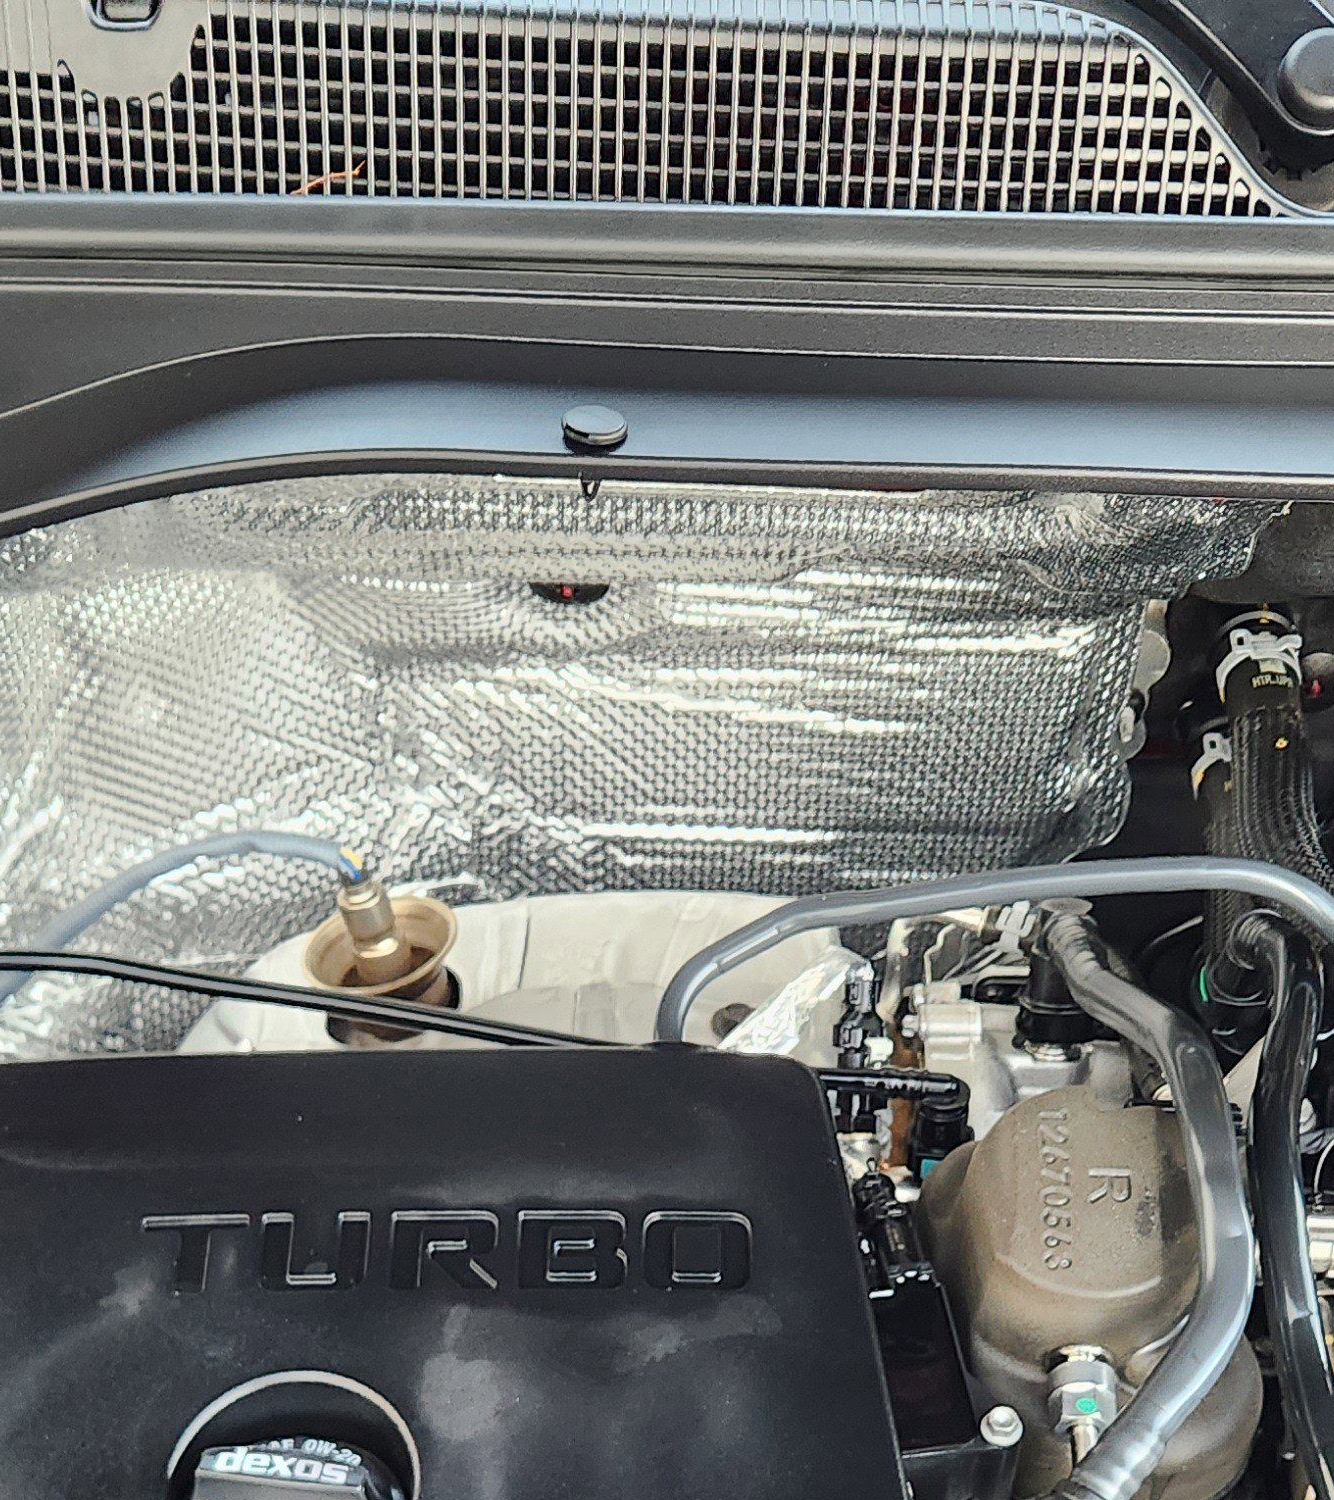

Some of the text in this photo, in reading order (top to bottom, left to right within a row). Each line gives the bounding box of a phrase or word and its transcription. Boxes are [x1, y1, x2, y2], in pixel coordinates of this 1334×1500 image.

[1038, 1108, 1073, 1271] 12670568
[1087, 1168, 1132, 1204] R
[141, 1209, 754, 1293] TURBO
[214, 1446, 349, 1485] dexos
[301, 1439, 362, 1467] 0W-20
